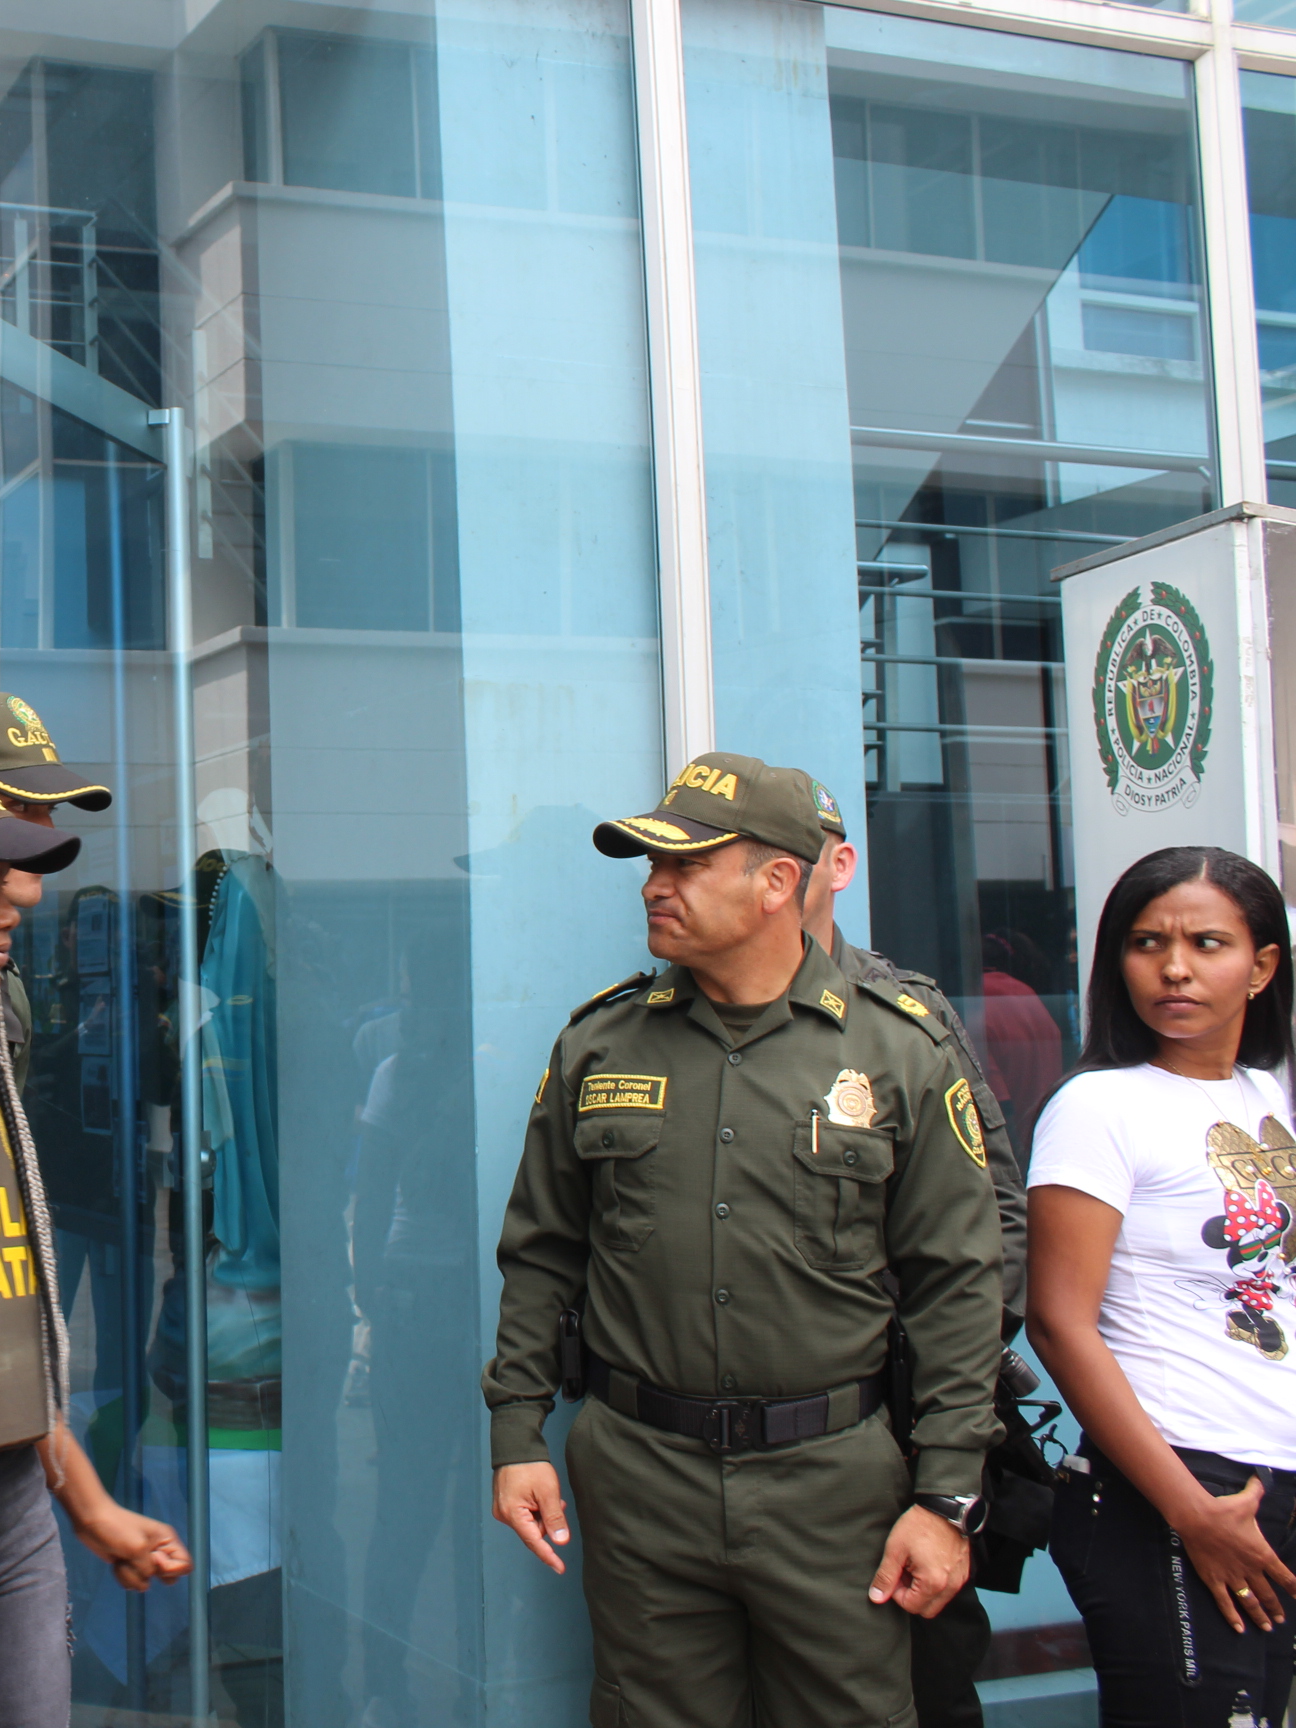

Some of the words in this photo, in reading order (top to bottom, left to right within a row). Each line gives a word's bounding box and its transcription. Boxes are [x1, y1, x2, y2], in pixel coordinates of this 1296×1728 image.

[1142, 609, 1156, 622] DE
[1165, 615, 1198, 701] COLOMBIA
[1113, 737, 1144, 783] POLICIA
[1154, 722, 1195, 783] NACIONAL
[1124, 784, 1146, 806] DIOS
[1146, 794, 1153, 807] Y
[1155, 777, 1187, 807] PATRIA
[585, 1093, 608, 1105] OSCAR
[609, 1092, 650, 1103] LAMPREA
[588, 1081, 616, 1091] Teniente
[618, 1080, 652, 1091] Coronel
[1171, 1555, 1184, 1584] NEW
[1175, 1586, 1191, 1620] YORK
[1180, 1621, 1194, 1656] PARIS
